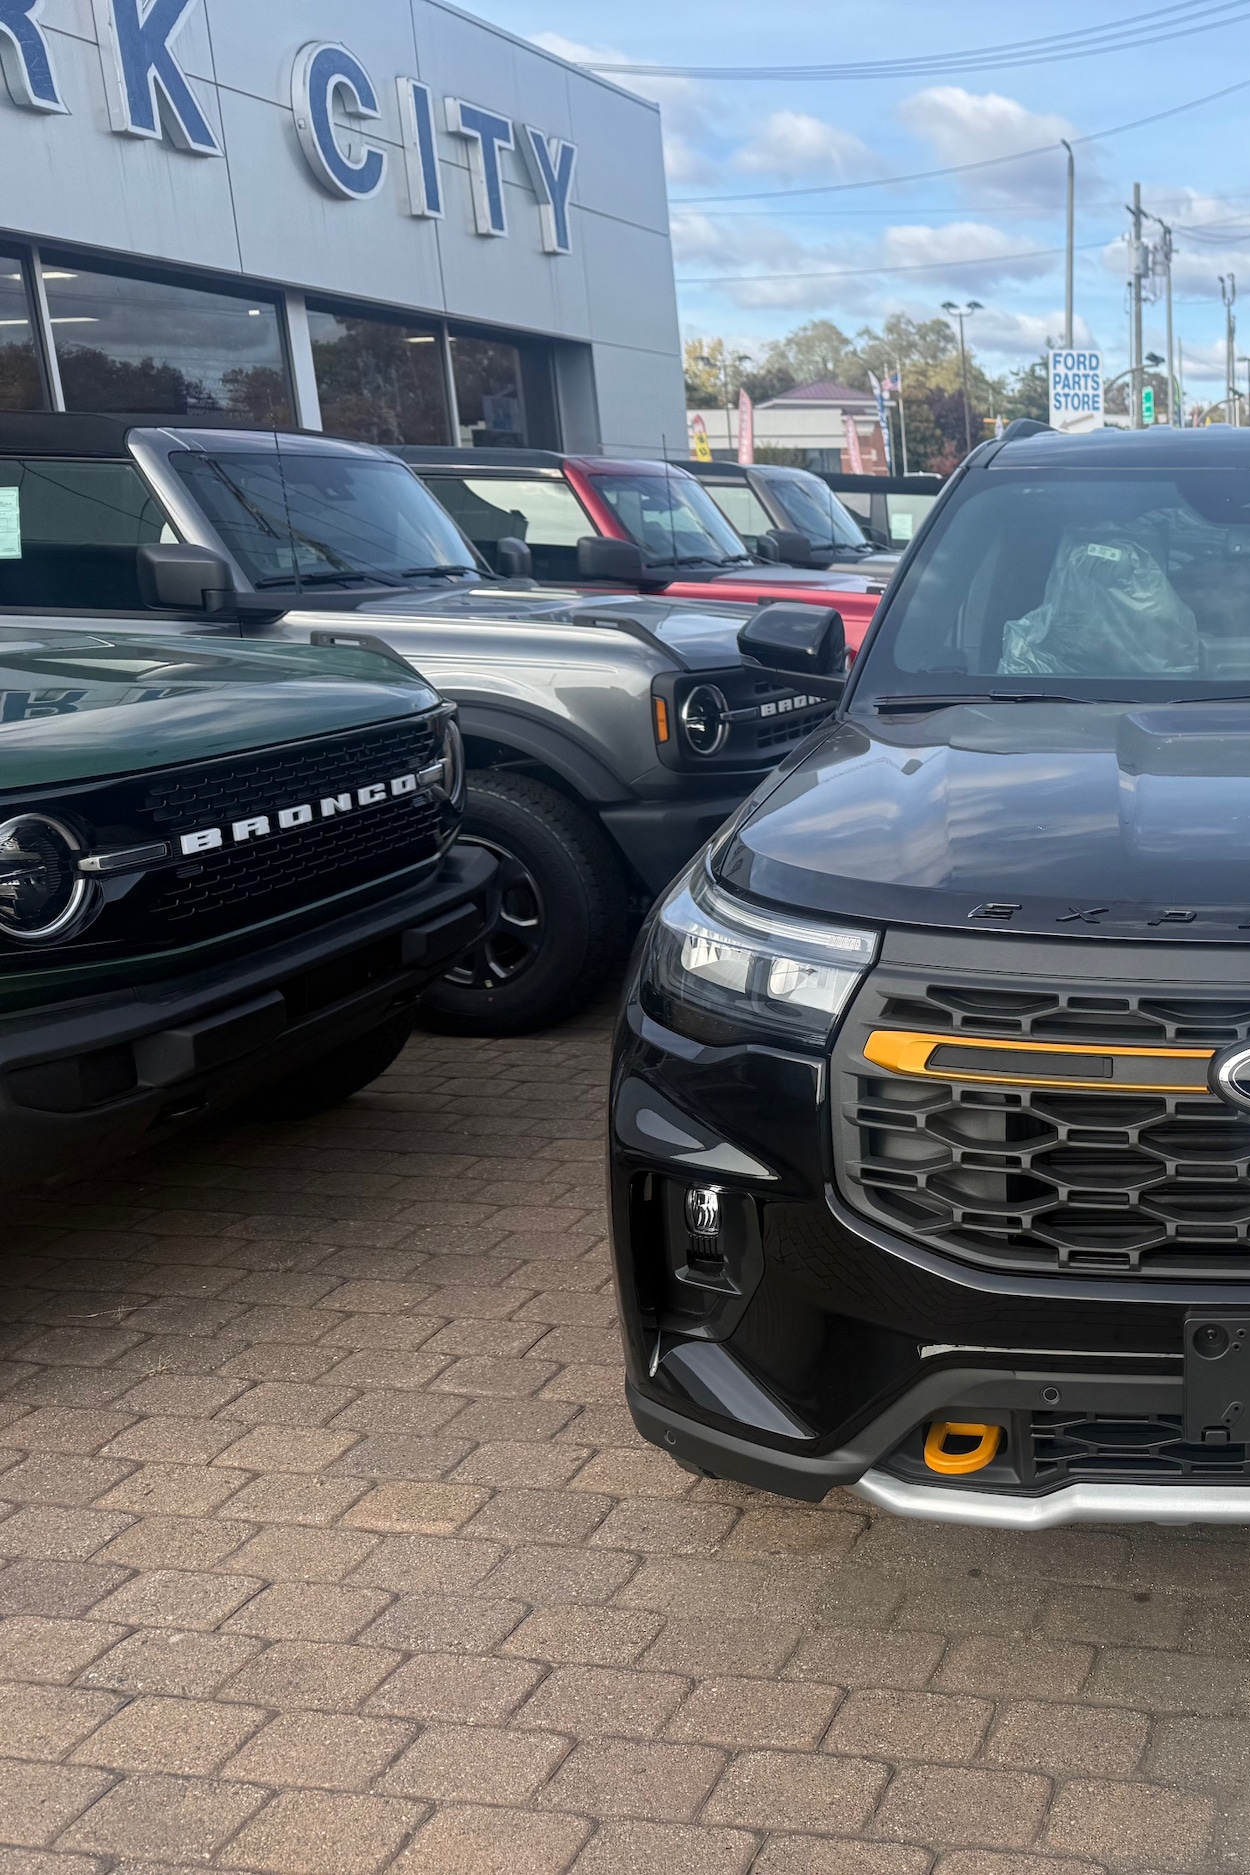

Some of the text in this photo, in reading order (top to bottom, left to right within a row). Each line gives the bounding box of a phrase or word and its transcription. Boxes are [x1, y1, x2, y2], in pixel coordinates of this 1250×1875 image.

[292, 41, 578, 254] CITY
[1053, 353, 1100, 371] FORD
[1053, 373, 1100, 391] PARTS
[1053, 392, 1100, 411] STORE
[760, 694, 827, 717] BRON
[180, 773, 416, 855] BRONCO
